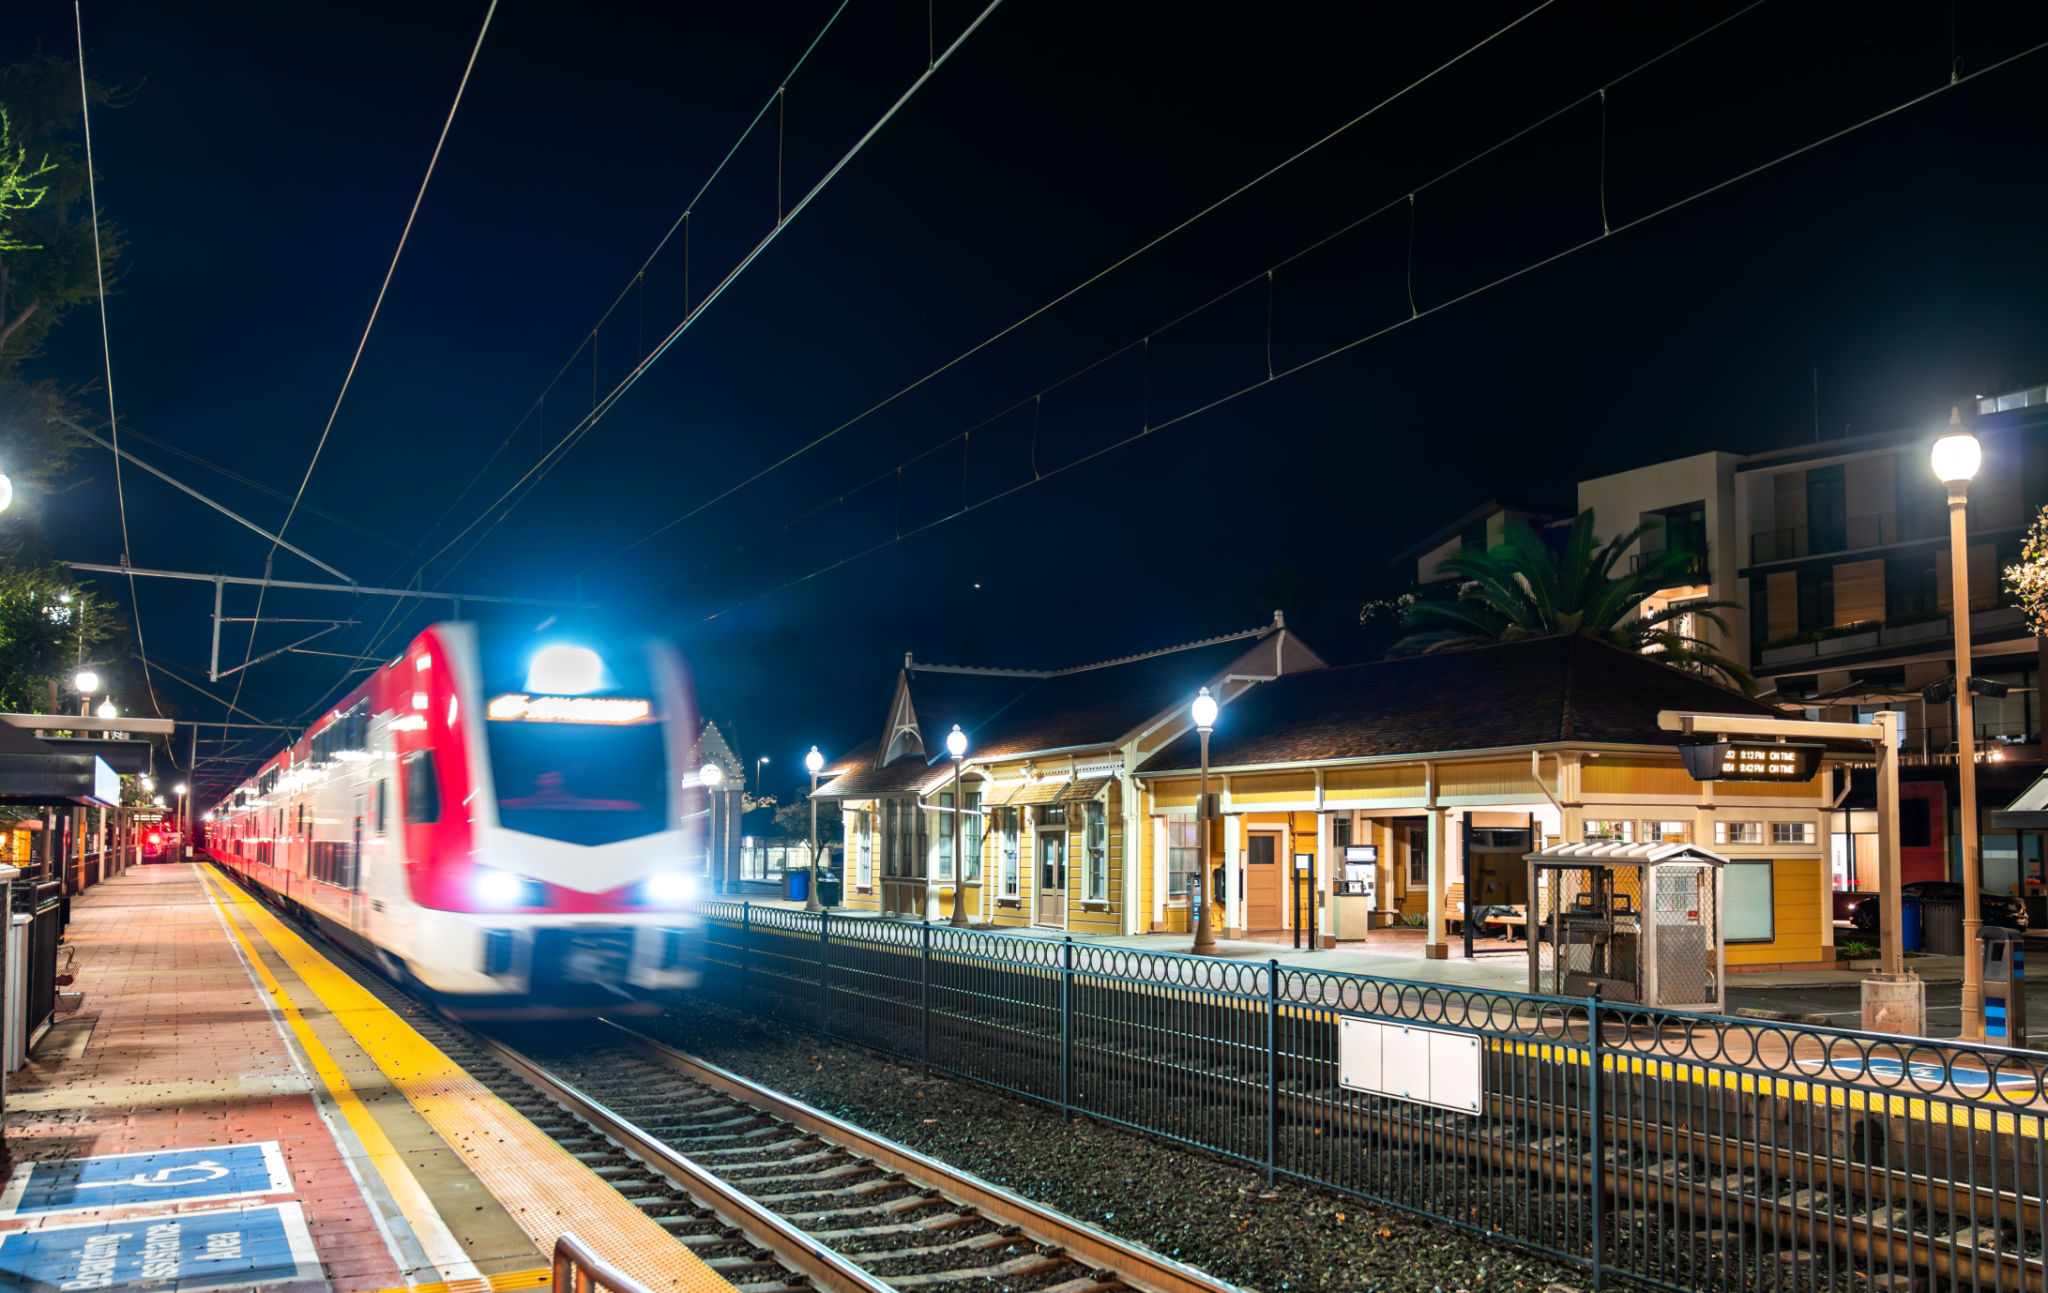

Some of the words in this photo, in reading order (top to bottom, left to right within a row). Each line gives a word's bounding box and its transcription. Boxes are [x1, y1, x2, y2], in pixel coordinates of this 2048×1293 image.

[1741, 751, 1754, 760] 9:12
[1755, 751, 1765, 760] PM
[1770, 752, 1780, 760] ON
[1781, 752, 1795, 761] TIME
[1740, 763, 1753, 772] 9:42
[1754, 764, 1764, 772] PM
[1769, 764, 1779, 773] ON
[1780, 765, 1795, 774] TIME
[194, 1231, 242, 1260] Area
[60, 1232, 133, 1291] Boarding
